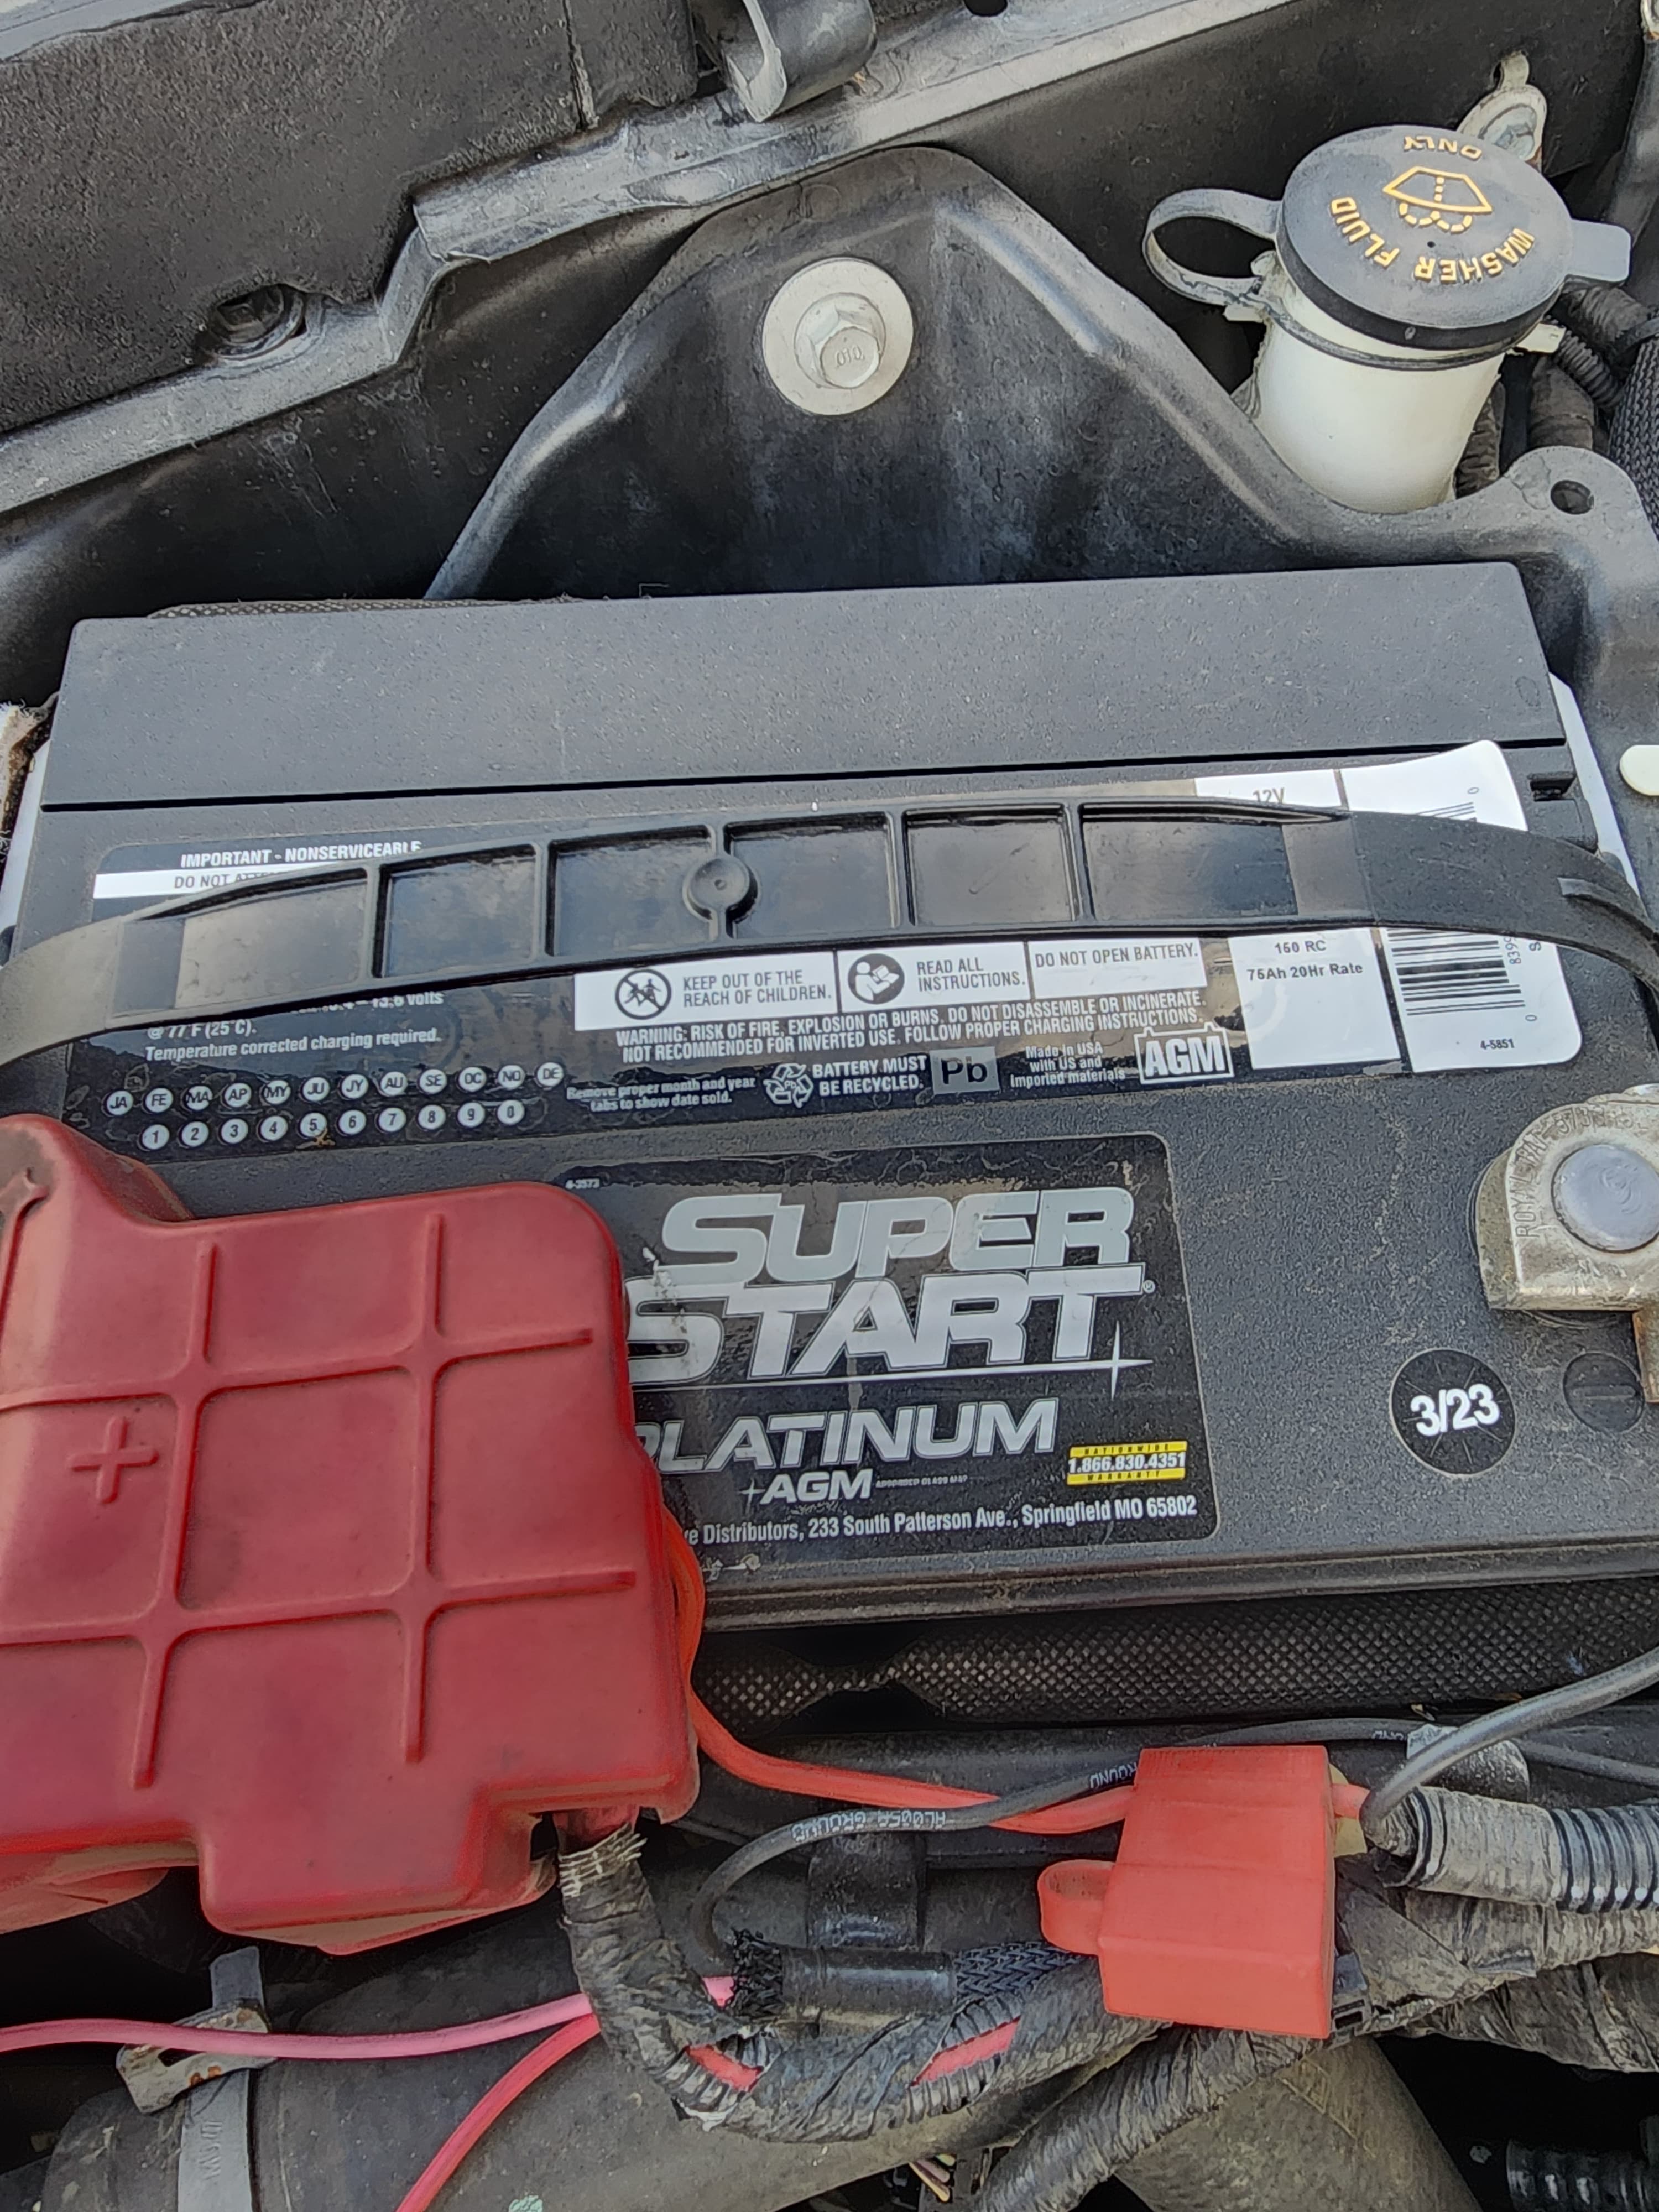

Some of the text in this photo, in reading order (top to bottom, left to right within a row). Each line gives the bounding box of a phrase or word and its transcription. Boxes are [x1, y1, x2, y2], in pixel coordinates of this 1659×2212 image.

[1403, 135, 1483, 161] ONLY
[1331, 196, 1536, 283] WASHER FLUID
[1253, 787, 1285, 804] 12V
[181, 849, 272, 868] IMPORTANT
[174, 875, 195, 889] DO
[1035, 942, 1198, 968] DO NOT OPEN BATTERY.
[1305, 940, 1327, 952] RC
[916, 957, 984, 976] READ ALL
[1290, 964, 1324, 978] 20Hr
[1328, 962, 1364, 975] Rate
[683, 969, 803, 991] KEEP OUT OF THE
[918, 971, 1025, 992] INSTRUCTIONS.
[684, 984, 832, 1008] REACH OF CHILDREN.
[615, 1026, 688, 1047] WARNING:
[691, 1022, 725, 1041] RISK
[727, 1021, 746, 1039] OF
[788, 1013, 864, 1036] EXPLOSION
[868, 1012, 888, 1029] OR
[891, 1008, 945, 1026] BURNS.
[948, 1006, 968, 1023] DO
[971, 1004, 999, 1022] NOT
[1002, 998, 1097, 1020] DISASSEMBLE
[1100, 996, 1120, 1013] OR
[1123, 990, 1207, 1013] INCINERATE.
[144, 1027, 442, 1063] Temperature corrected charging required.
[623, 1006, 1204, 1063] NOT RECOMMENDED FOR INVERTED USE. FOLLOW PROPER CHARGING INSTRUCTIONS.
[1025, 1041, 1104, 1060] Made in USA
[1144, 1035, 1227, 1078] AGM
[811, 1055, 928, 1079] BATTERY MUST
[941, 1055, 988, 1085] Pb
[1029, 1054, 1103, 1073] with US and
[1067, 1066, 1126, 1084] materials
[150, 1093, 168, 1107] FE
[227, 1088, 248, 1100] AP
[306, 1082, 325, 1094] JU
[346, 1078, 364, 1093] JY
[425, 1074, 442, 1087] SE
[502, 1070, 521, 1082] NO
[542, 1067, 560, 1080] DE
[566, 1075, 756, 1100] Remove proper month and year
[818, 1081, 841, 1097] BE
[590, 1091, 733, 1113] tabs to show date sold.
[152, 1130, 159, 1144] 1
[191, 1127, 200, 1141] 2
[229, 1124, 239, 1138] 3
[269, 1121, 278, 1134] 4
[309, 1118, 318, 1131] 5
[348, 1115, 357, 1129] 6
[388, 1113, 397, 1126] 7
[427, 1110, 436, 1124] 8
[467, 1108, 476, 1121] 9
[662, 1185, 1136, 1283] SUPER
[625, 1261, 1146, 1384] START
[1410, 1384, 1500, 1437] 3/23
[1084, 1443, 1168, 1455] NATIONWIDE
[1067, 1451, 1186, 1474] 1.866.830.4351
[759, 1468, 874, 1505] AGM
[702, 1520, 805, 1546] Distributors,
[808, 1516, 840, 1539] 233
[842, 1512, 891, 1537] South
[894, 1507, 972, 1533] Patterson
[1021, 1498, 1110, 1528] Springfield
[1114, 1498, 1144, 1520] MO
[1146, 1495, 1198, 1517] 65802
